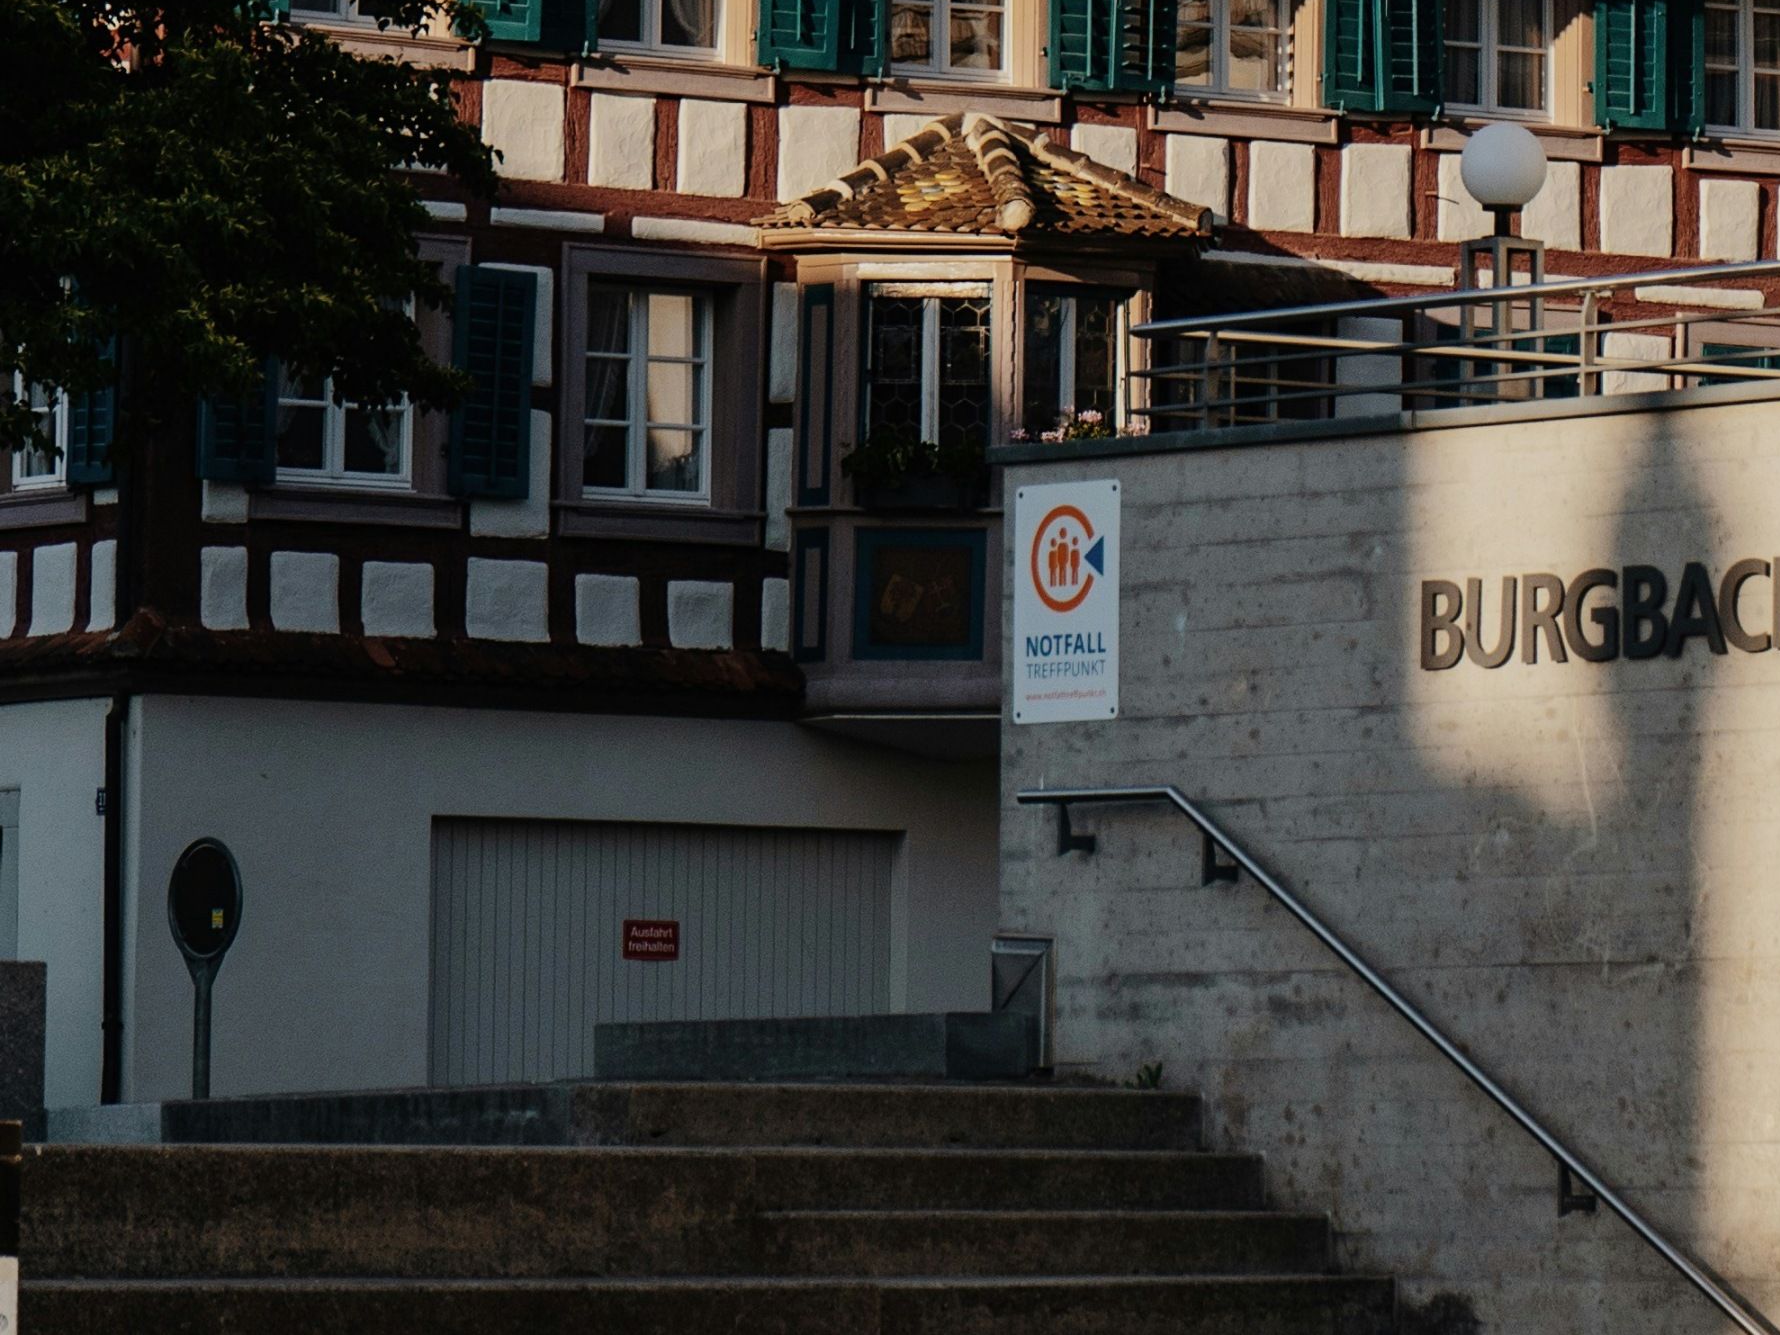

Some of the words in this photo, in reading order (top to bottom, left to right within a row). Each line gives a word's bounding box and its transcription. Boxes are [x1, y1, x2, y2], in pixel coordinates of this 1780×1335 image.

[1026, 632, 1106, 657] NOTFALL
[1026, 659, 1106, 680] TREFFPUNKT
[630, 926, 673, 938] Ausfahrt
[628, 940, 675, 953] freihalten
